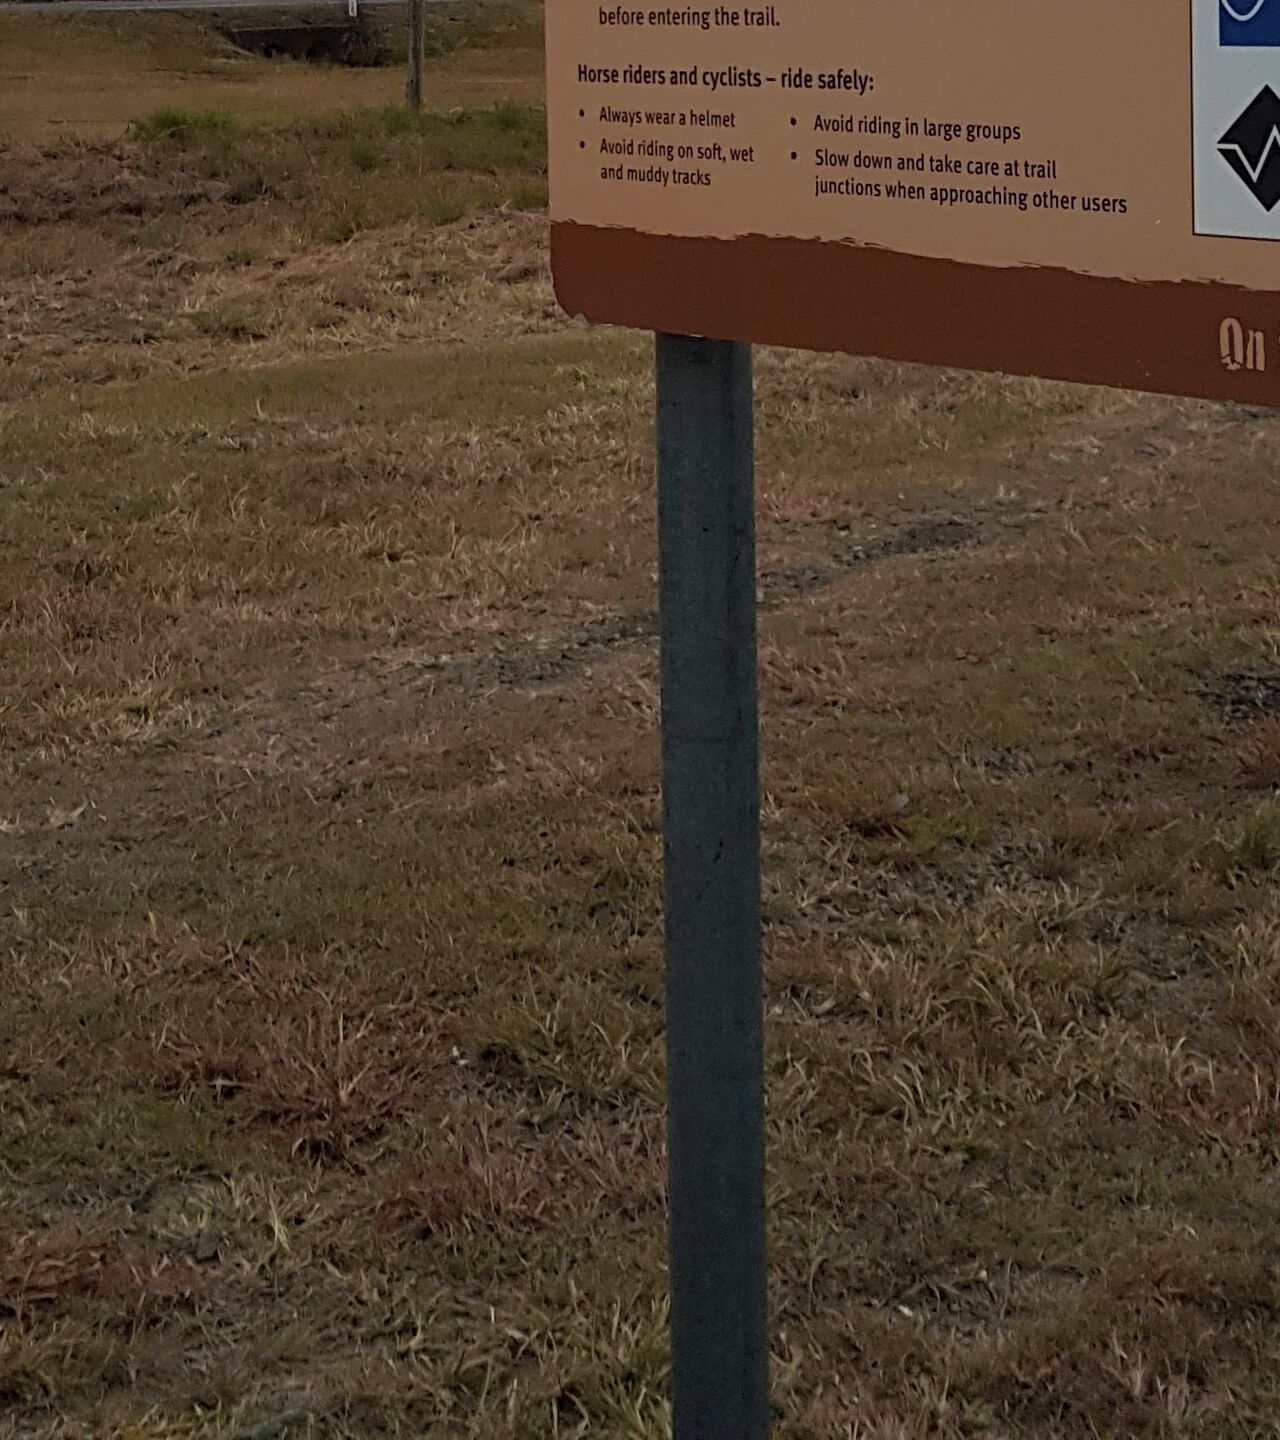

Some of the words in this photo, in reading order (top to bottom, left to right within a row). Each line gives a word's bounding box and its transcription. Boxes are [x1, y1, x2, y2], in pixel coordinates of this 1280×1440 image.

[598, 5, 645, 26] before
[648, 6, 711, 31] entering
[714, 6, 740, 26] the
[743, 5, 780, 27] trail.
[577, 63, 619, 84] Horse
[623, 63, 666, 85] riders
[669, 65, 698, 86] and
[702, 66, 762, 92] cyclists
[781, 67, 813, 89] ride
[817, 68, 874, 96] safely:
[599, 105, 643, 128] Always
[644, 111, 676, 126] wear
[678, 112, 687, 126] a
[689, 108, 736, 128] helmet
[813, 114, 854, 133] Avoid
[858, 114, 902, 140] riding
[904, 117, 919, 136] in
[923, 117, 962, 142] large
[966, 124, 1021, 145] groups
[599, 138, 634, 156] Avoid
[637, 139, 675, 162] riding
[677, 145, 694, 159] on
[697, 142, 727, 163] soft,
[729, 146, 755, 163] wet
[815, 148, 850, 167] Slow
[853, 150, 893, 170] down
[896, 153, 925, 172] and
[928, 153, 962, 174] take
[966, 160, 1000, 176] care
[1004, 159, 1020, 177] at
[1023, 159, 1057, 180] trail
[600, 163, 624, 181] and
[627, 165, 670, 188] muddy
[672, 168, 712, 186] tracks
[814, 175, 882, 198] junctions
[884, 180, 925, 200] when
[929, 185, 1029, 212] approaching
[1032, 189, 1077, 210] other
[1081, 196, 1128, 214] users
[1219, 317, 1266, 372] On
